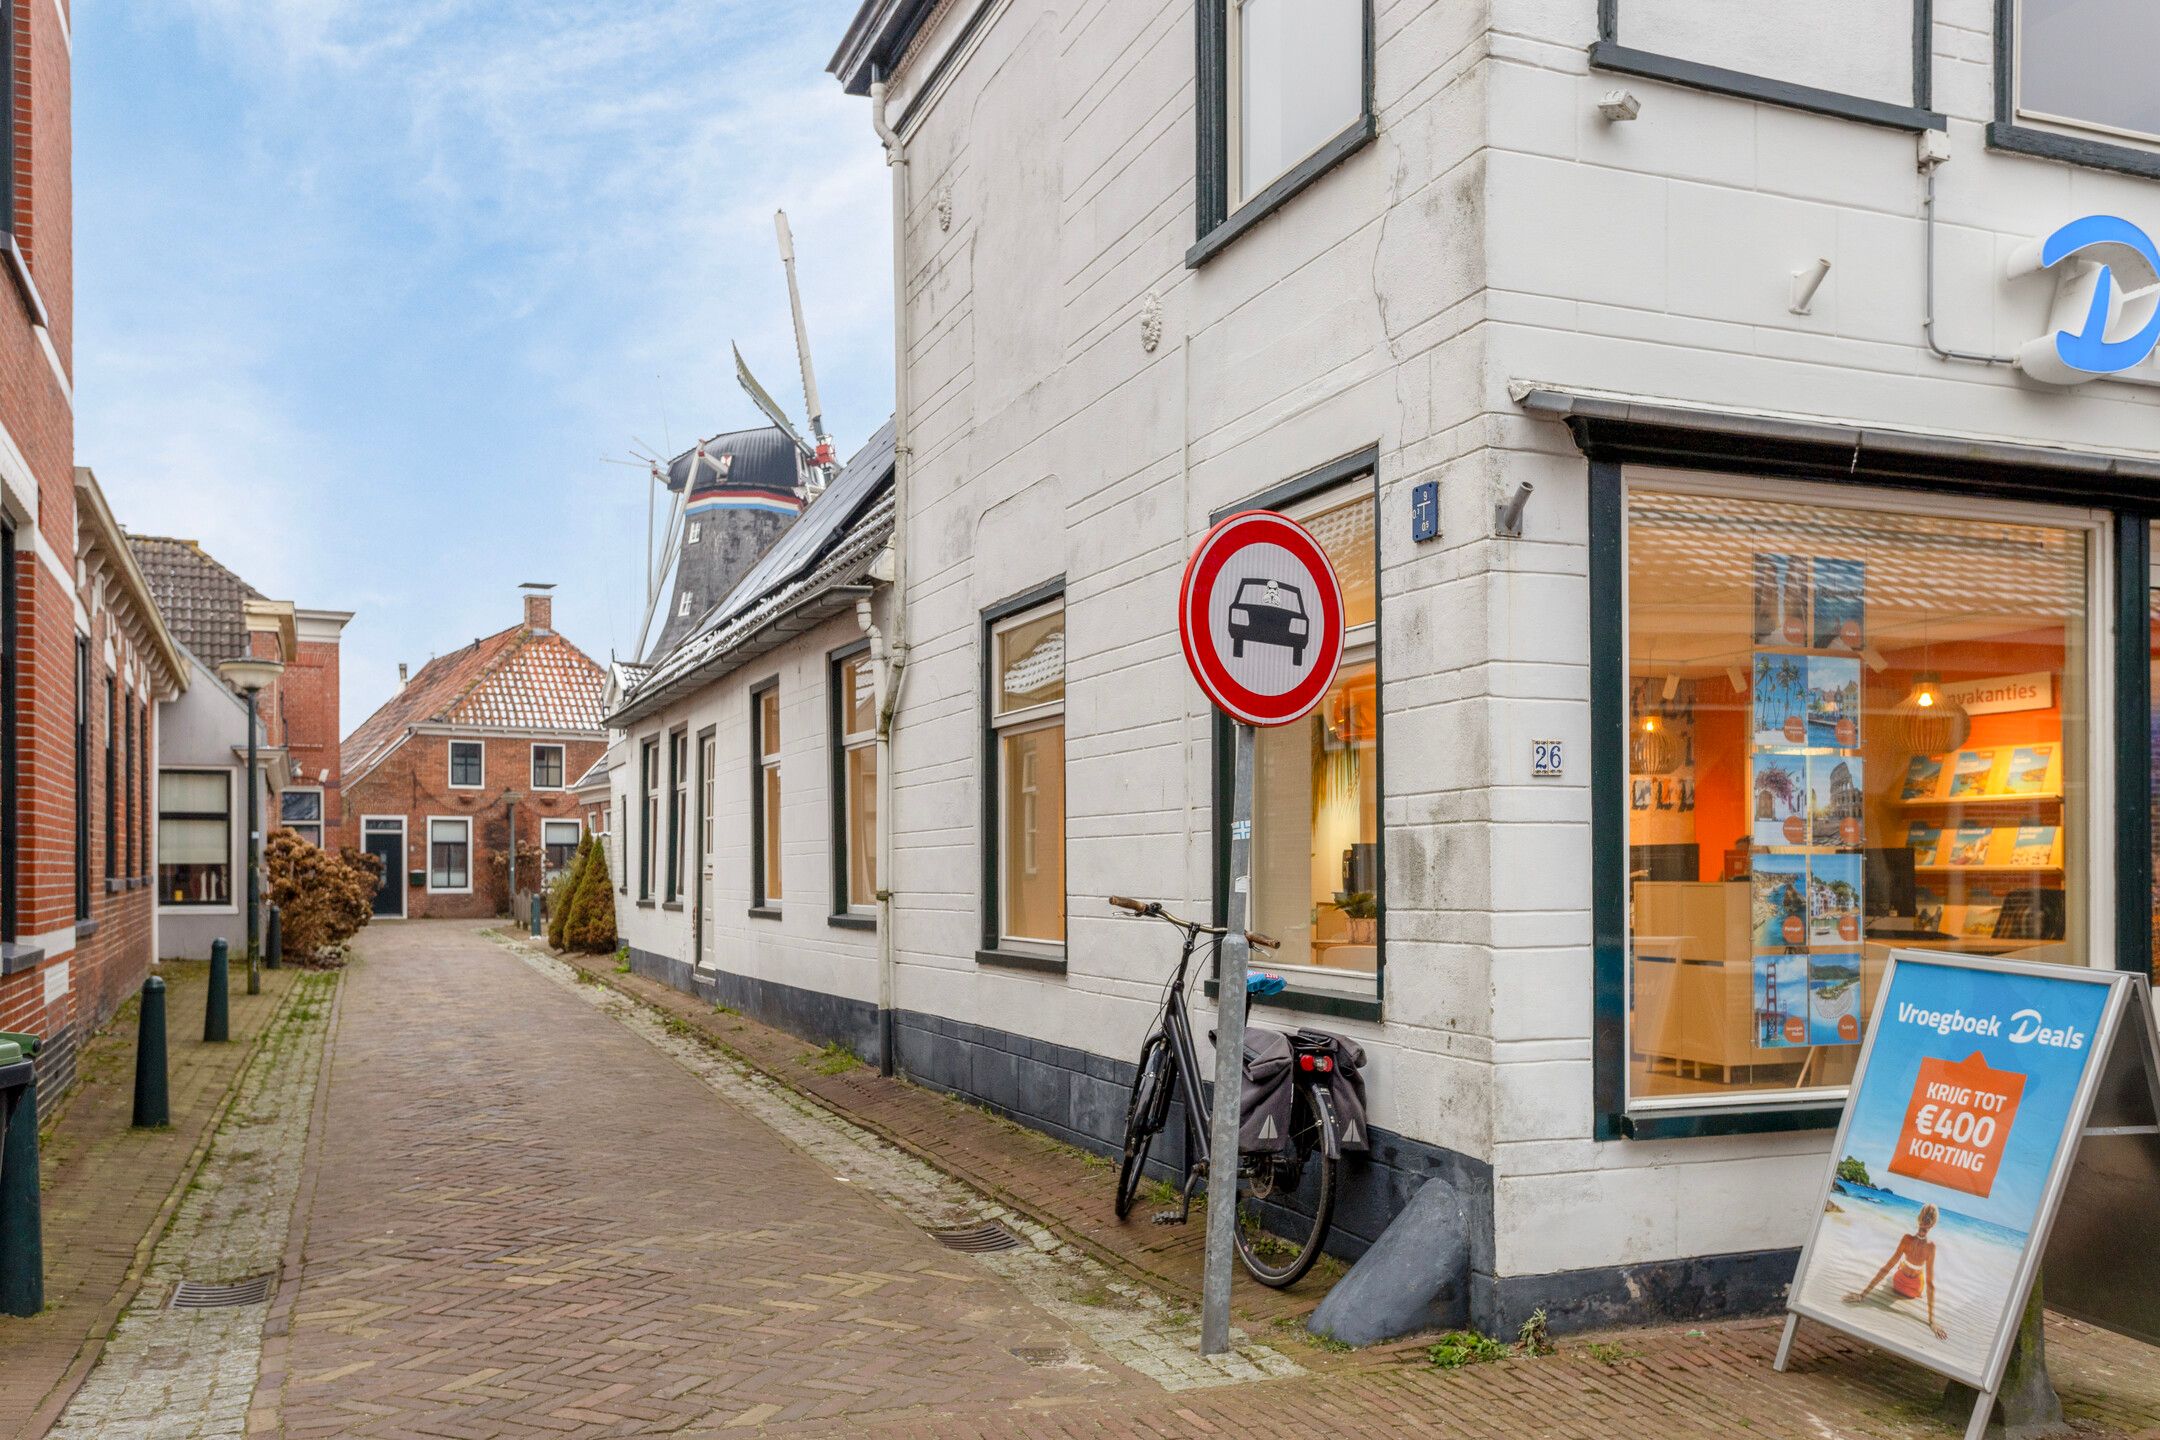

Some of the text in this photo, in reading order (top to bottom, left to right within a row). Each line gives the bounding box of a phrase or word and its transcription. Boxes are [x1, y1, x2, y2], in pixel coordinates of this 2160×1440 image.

[1535, 745, 1562, 769] 26
[1898, 1002, 2085, 1050] Vroegboek Deals
[1926, 1081, 2007, 1112] KRIJG TOT
[1915, 1104, 1996, 1148] €400
[1909, 1138, 1985, 1172] KORTING
